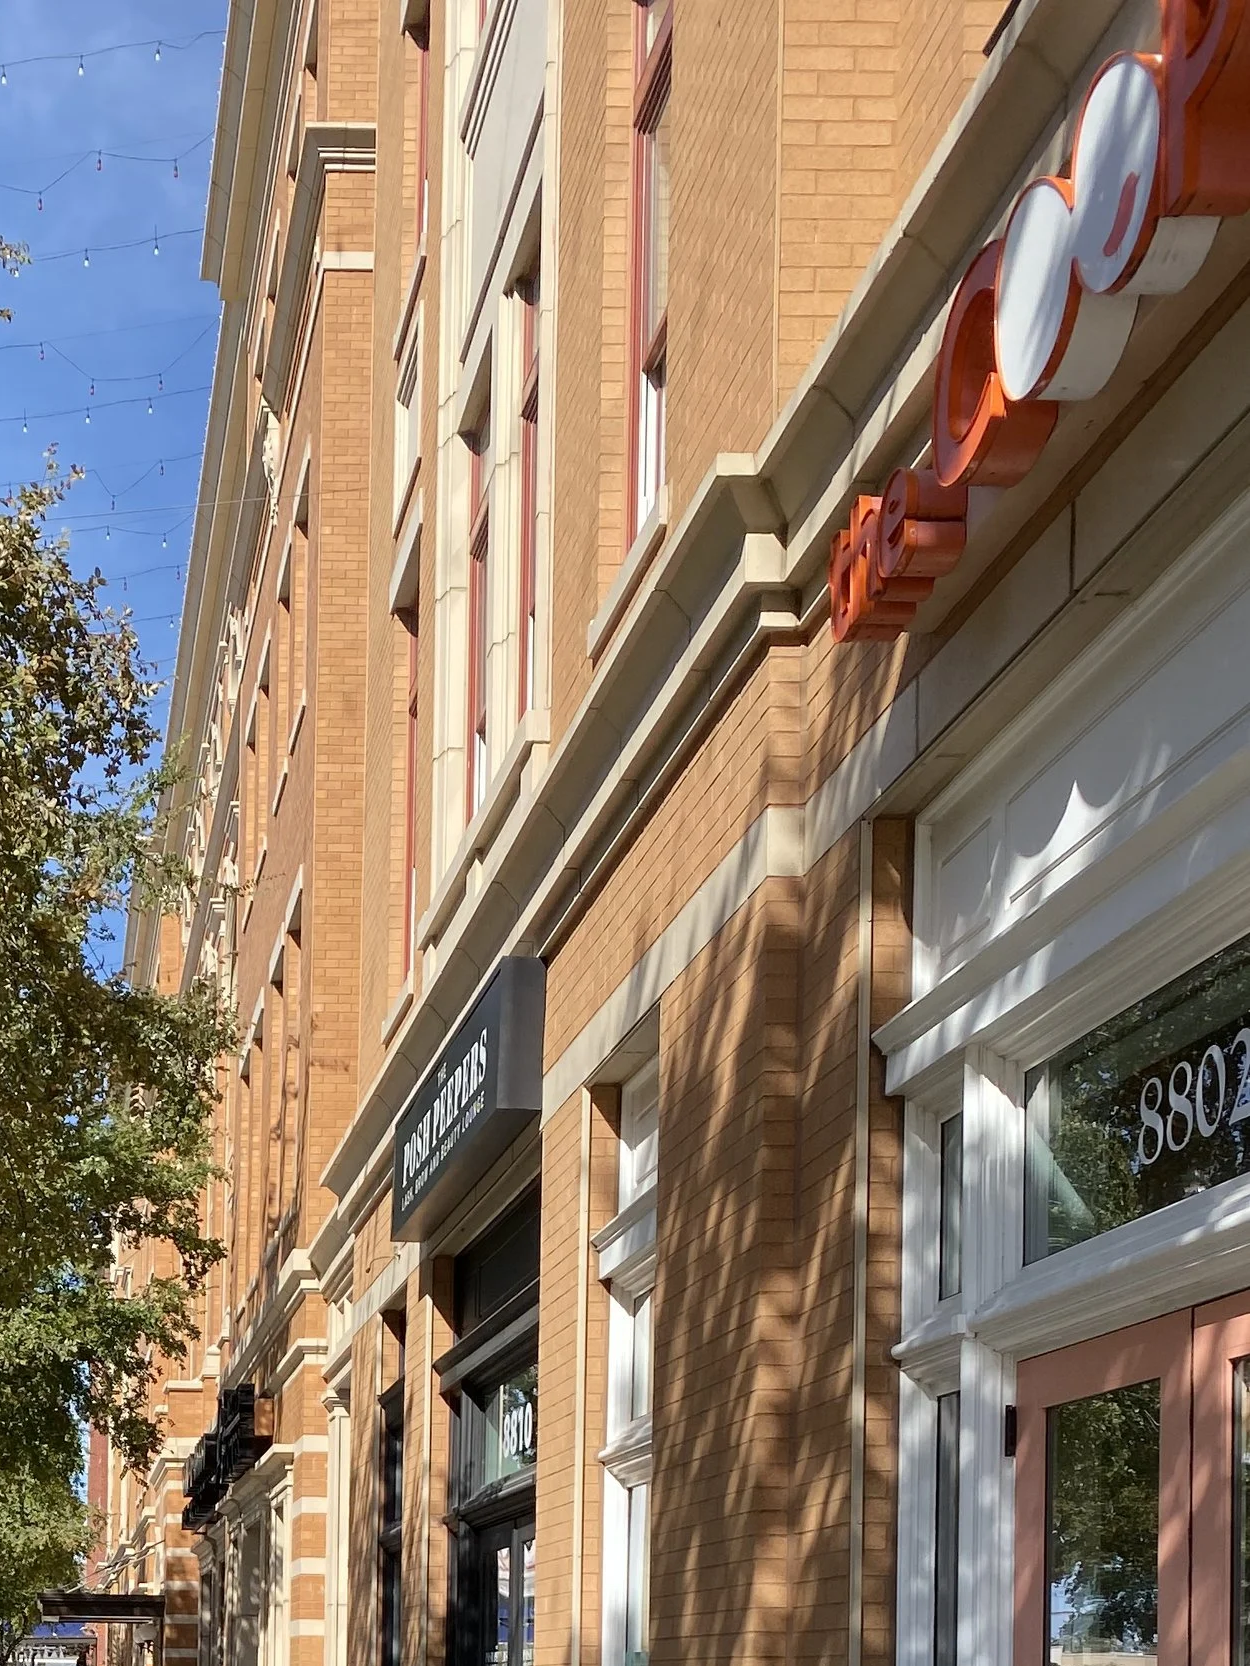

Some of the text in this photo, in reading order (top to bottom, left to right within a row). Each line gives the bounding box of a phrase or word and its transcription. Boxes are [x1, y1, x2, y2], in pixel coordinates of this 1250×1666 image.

[402, 1026, 488, 1188] POSH PEEPERS
[437, 1061, 447, 1088] THE
[1137, 1027, 1250, 1165] 8802
[401, 1090, 485, 1212] LASH BROW AND BEAUTY LOUNGE
[502, 1402, 533, 1459] 8810
